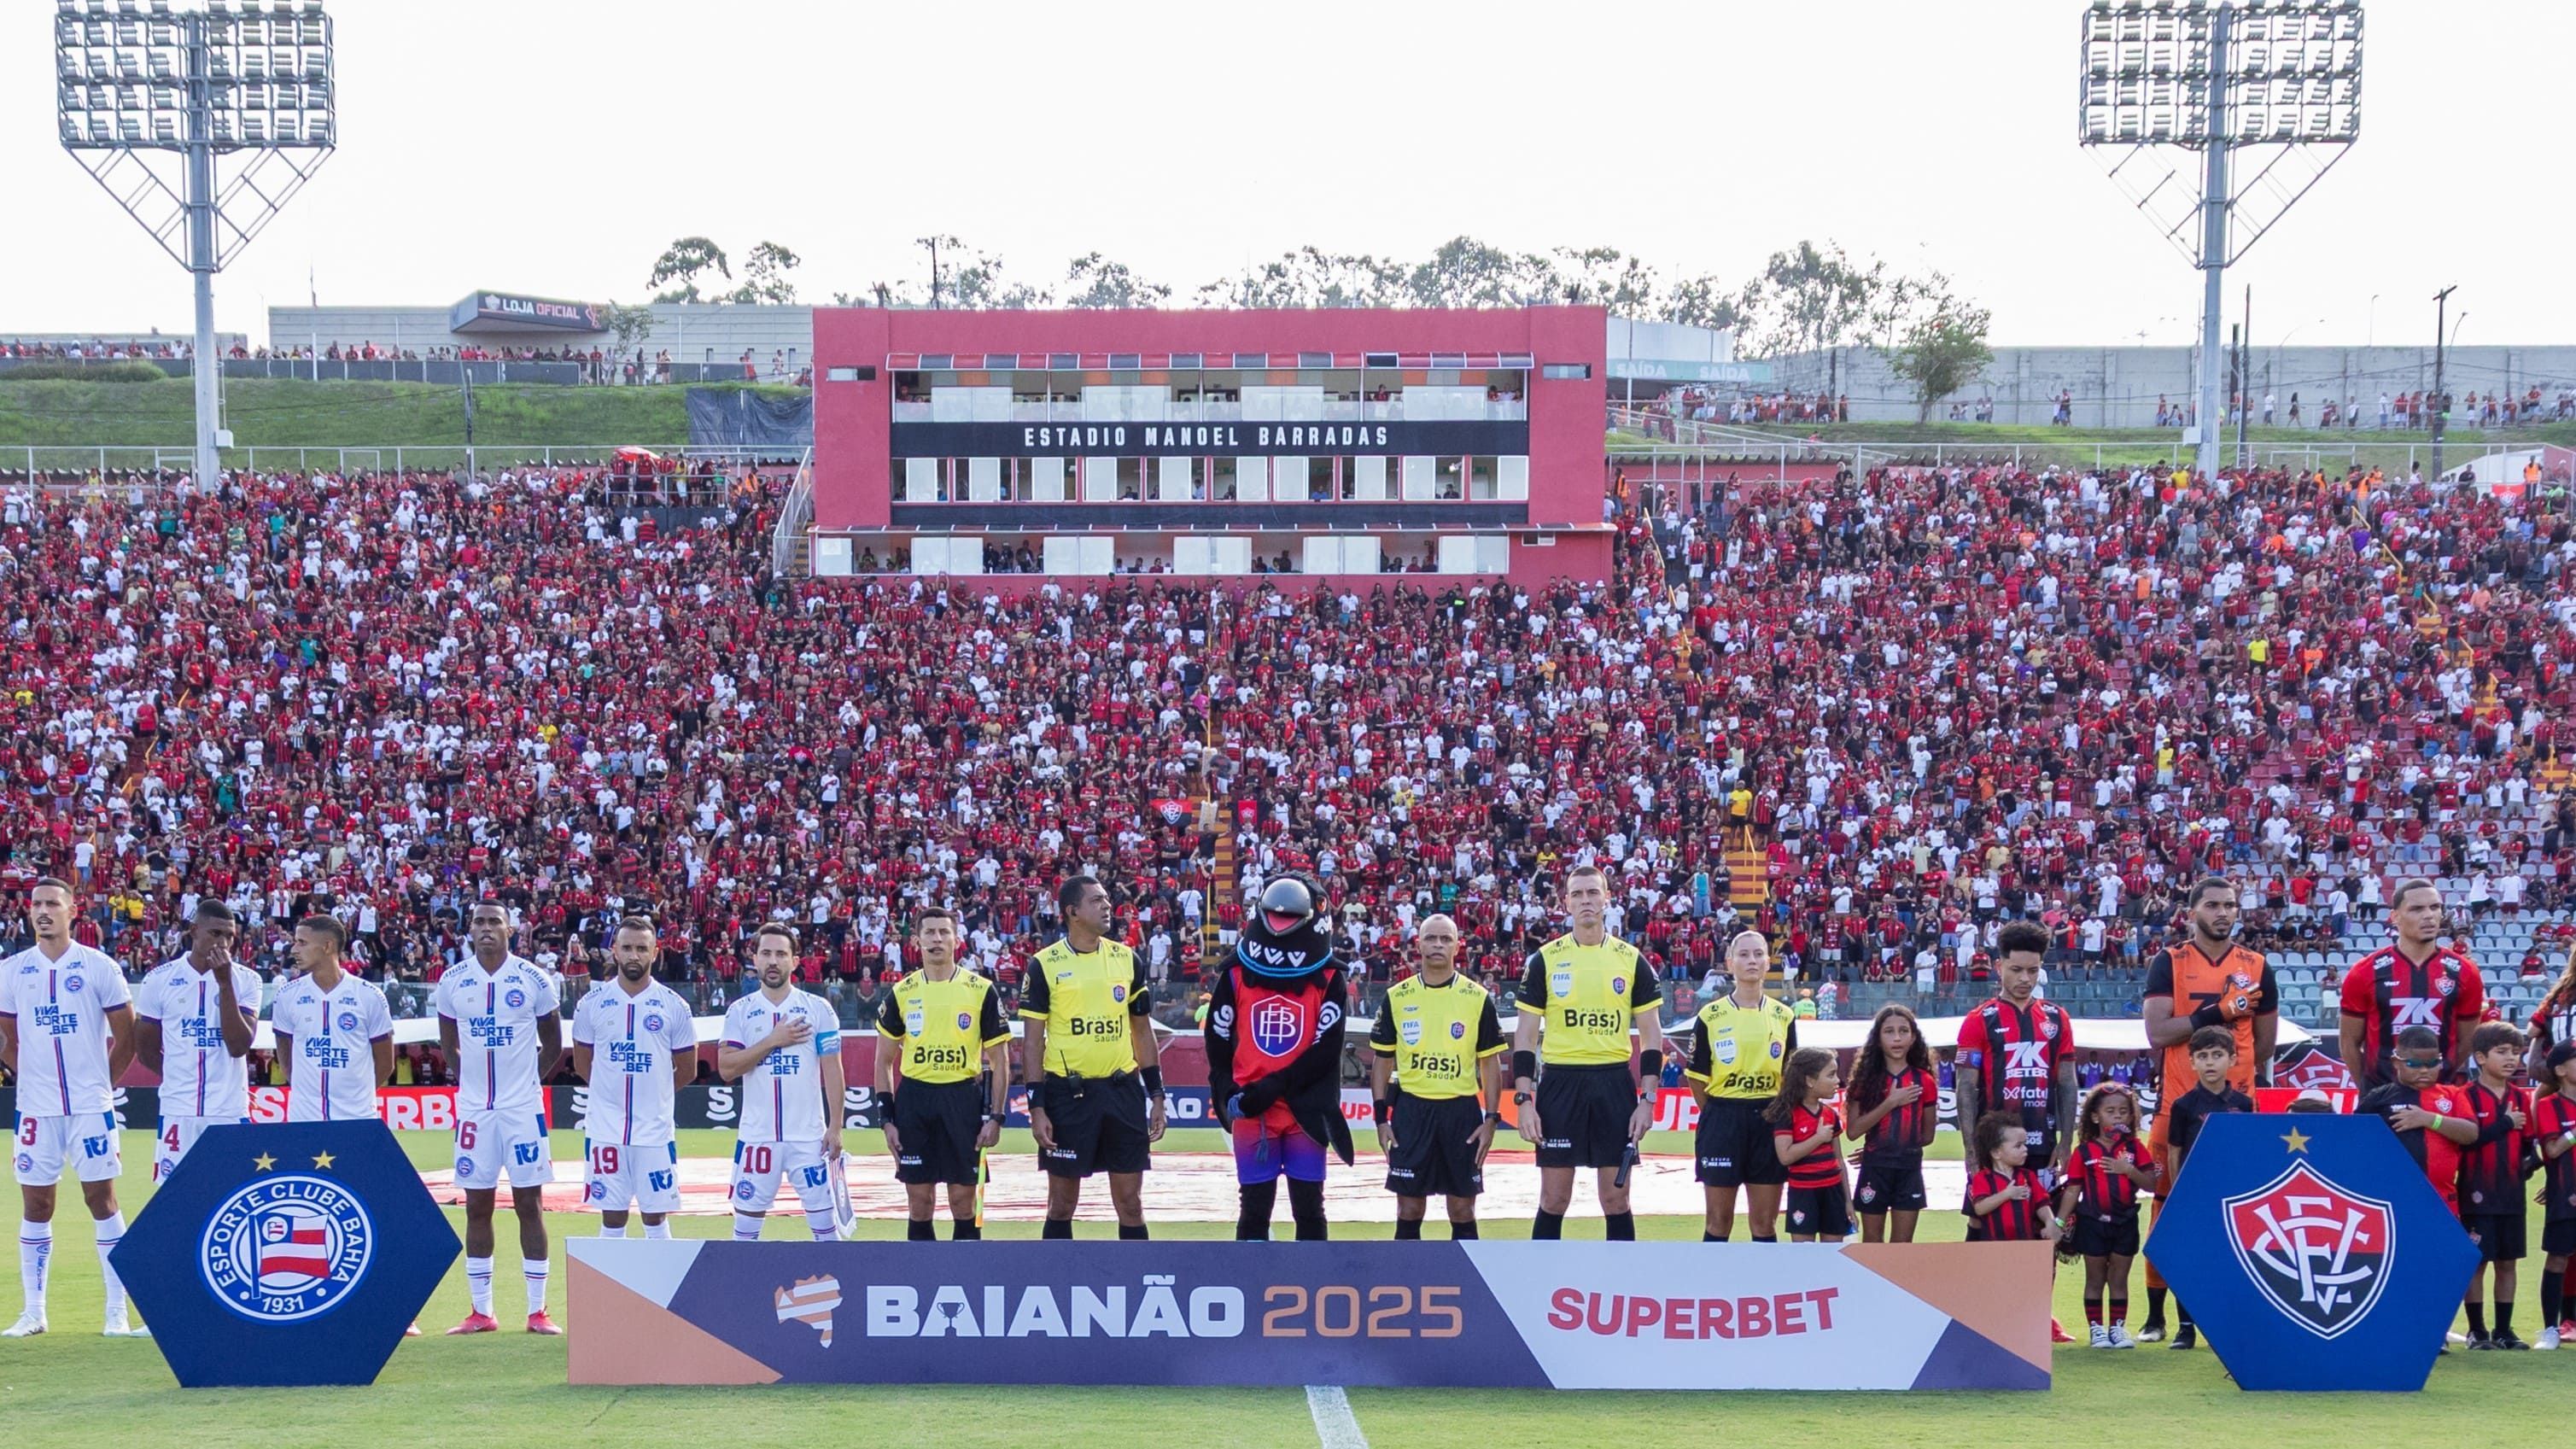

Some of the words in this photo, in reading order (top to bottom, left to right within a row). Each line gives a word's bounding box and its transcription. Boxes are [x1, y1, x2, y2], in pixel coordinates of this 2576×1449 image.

[503, 299, 534, 315] LOJA
[536, 303, 581, 319] OFICIAL
[1616, 360, 1667, 377] SAÍDA
[1700, 364, 1749, 381] SAÍDA
[1025, 427, 1126, 446] ESTADIO
[1146, 427, 1238, 446] MANOEL
[1259, 427, 1387, 446] BARRADAS
[2389, 997, 2442, 1025] 7K
[36, 1014, 78, 1026] SORTE
[1403, 1020, 1419, 1030] FIFA
[50, 1024, 78, 1035] .BET
[181, 1027, 223, 1037] SORTE
[470, 1026, 513, 1037] SORTE
[195, 1037, 224, 1048] .BET
[484, 1036, 514, 1047] .BET
[1716, 1039, 1734, 1049] FIFA
[306, 1048, 349, 1058] SORTE
[610, 1052, 652, 1063] SORTE
[2004, 1041, 2049, 1068] 7K
[318, 1058, 349, 1068] .BET
[622, 1062, 652, 1072] .BET
[770, 1066, 800, 1075] .BET
[20, 1117, 38, 1146] 3
[164, 1123, 180, 1152] 4
[460, 1121, 478, 1150] 6
[593, 1146, 619, 1175] 19
[745, 1146, 773, 1174] 10
[210, 1190, 265, 1288] ESPORTE
[271, 1183, 351, 1215] CLUBE
[330, 1217, 365, 1282] BAHIA
[262, 1295, 304, 1313] 1931
[867, 1275, 1245, 1338] BAIANÃO
[1261, 1285, 1463, 1338] 2025
[1547, 1287, 1839, 1341] SUPERBET
